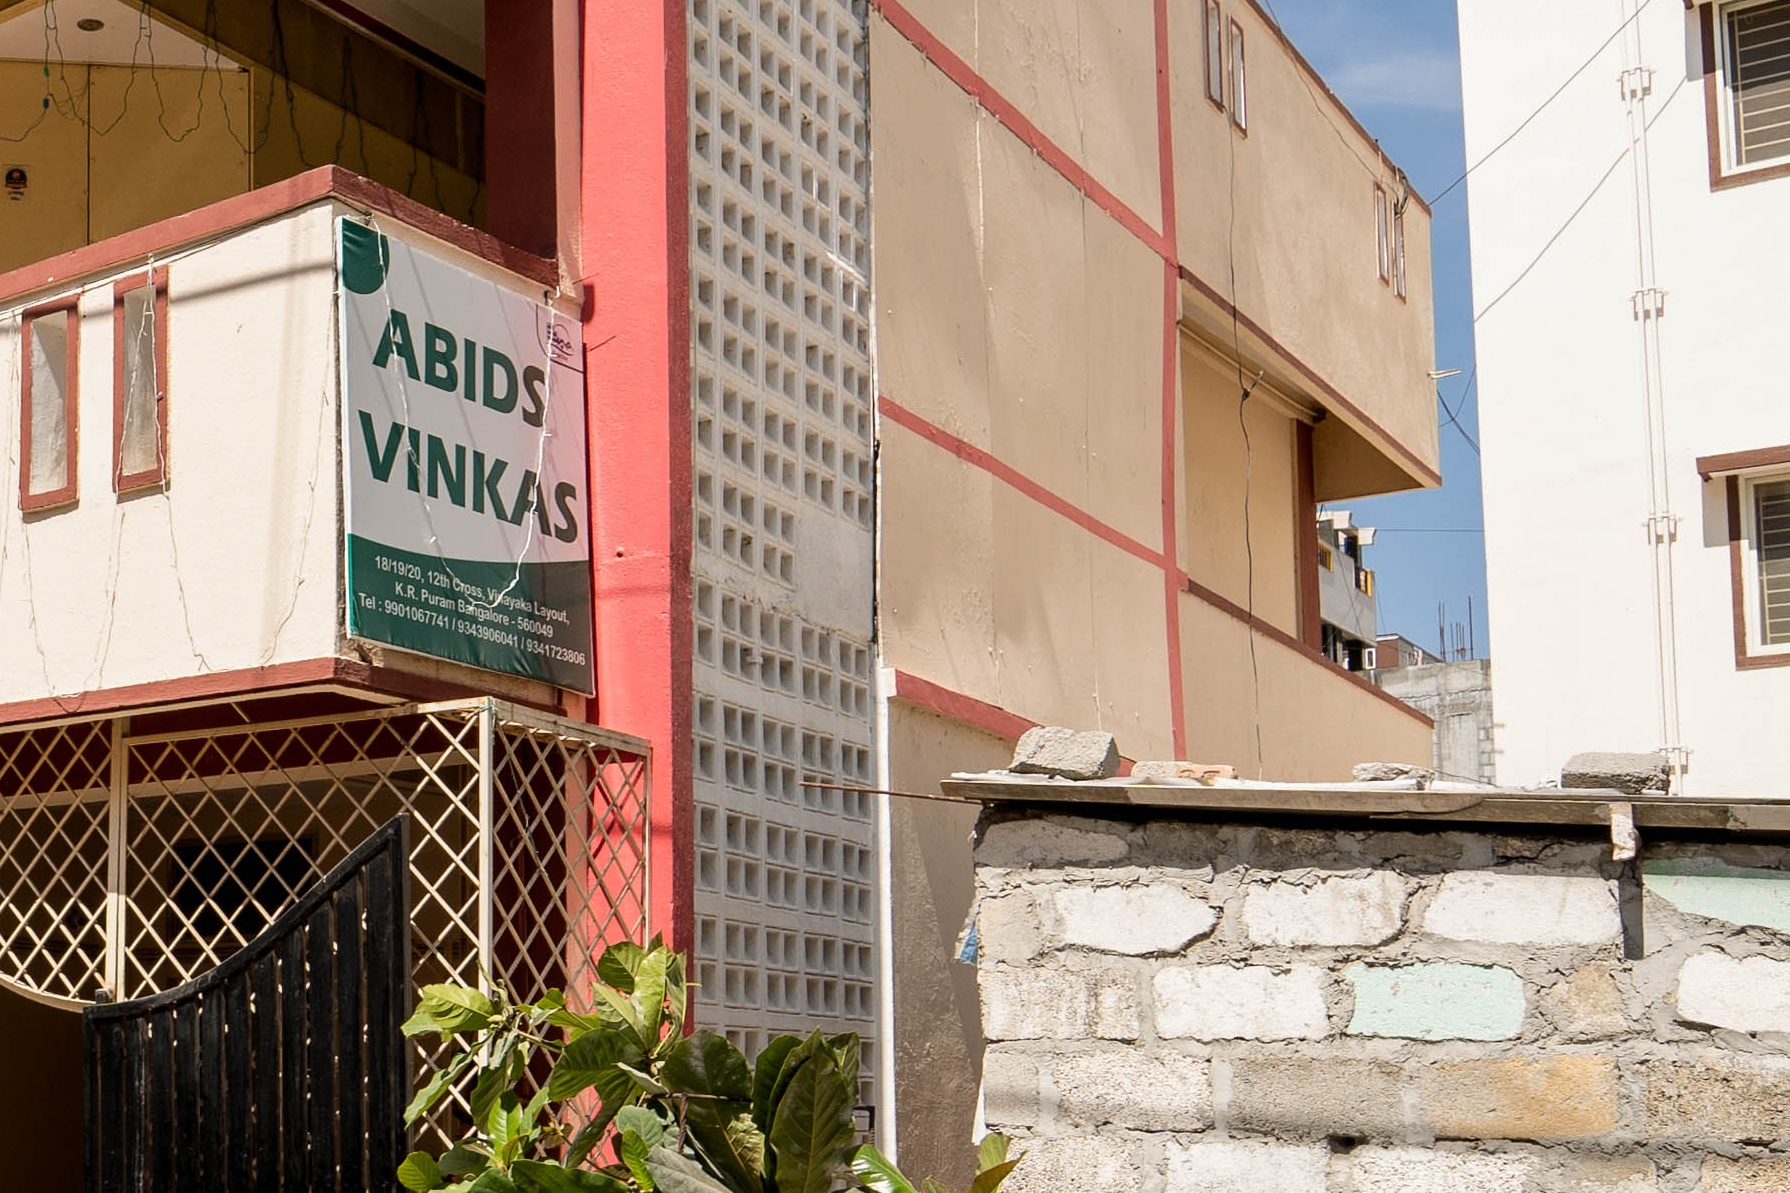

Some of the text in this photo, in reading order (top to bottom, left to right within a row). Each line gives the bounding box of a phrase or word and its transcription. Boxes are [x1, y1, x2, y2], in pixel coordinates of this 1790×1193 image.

[372, 308, 546, 427] ABIDS
[358, 410, 578, 544] VINKAS
[375, 555, 570, 626] 18/19/20, 12th Cross, Vinayaka Layout,
[395, 581, 418, 600] K.R.
[421, 589, 455, 610] Puram
[458, 600, 509, 625] Bangalore
[517, 617, 553, 638] 560049
[384, 600, 449, 629] 9901067741
[458, 620, 518, 648] 9343906041
[526, 638, 586, 665] 9341723806
